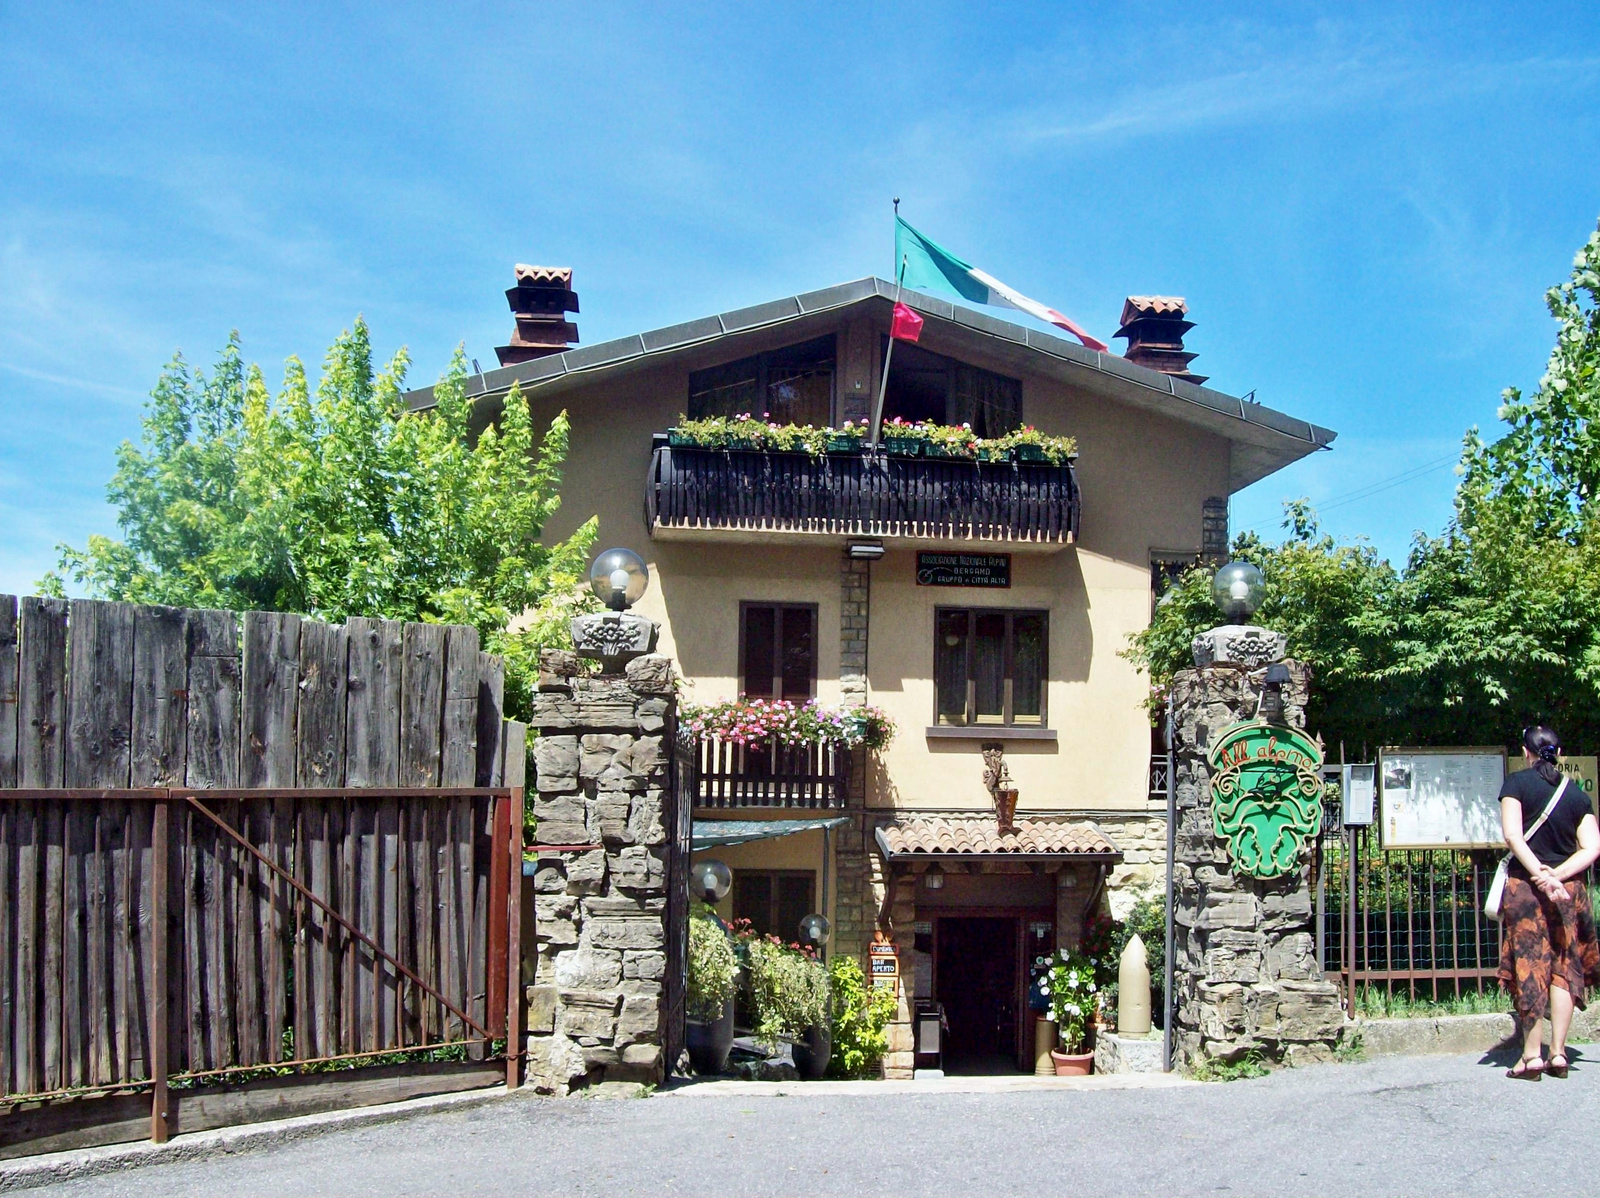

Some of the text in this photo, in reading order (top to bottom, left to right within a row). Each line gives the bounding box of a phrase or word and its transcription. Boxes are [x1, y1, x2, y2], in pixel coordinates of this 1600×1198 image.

[953, 567, 991, 576] BERGAMO
[937, 575, 963, 583] GRUPPO
[990, 577, 1006, 585] ALTA
